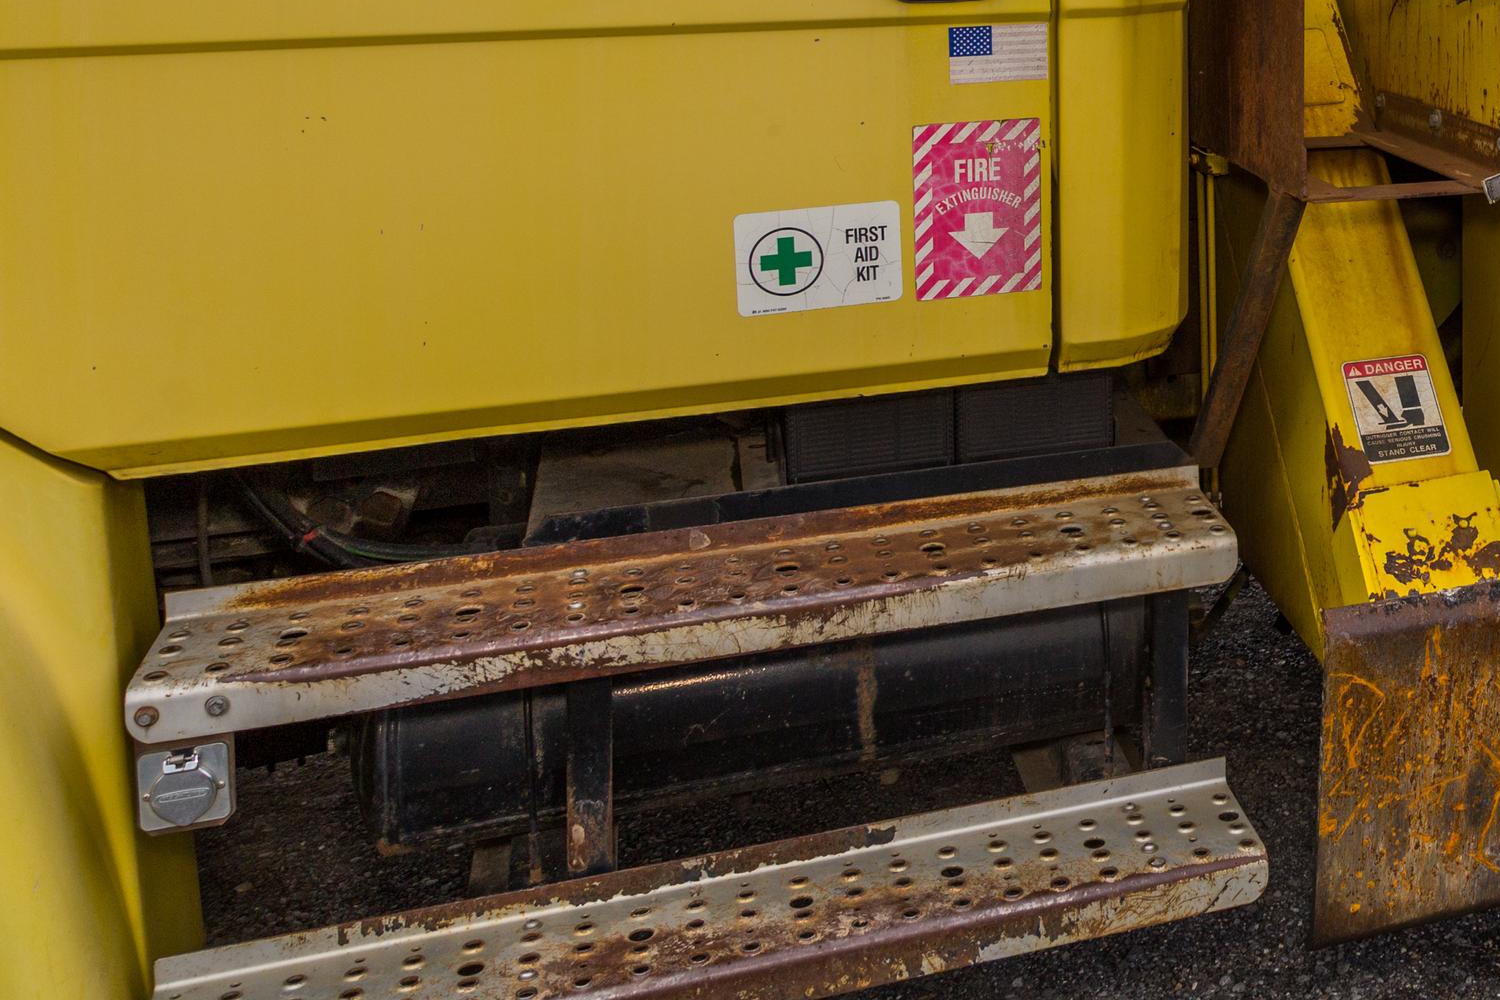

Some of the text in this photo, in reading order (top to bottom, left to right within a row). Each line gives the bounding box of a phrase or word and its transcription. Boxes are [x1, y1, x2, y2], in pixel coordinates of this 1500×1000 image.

[954, 157, 1001, 184] FIRE
[935, 187, 1022, 215] EXTINGUISHER
[845, 225, 887, 244] FIRST
[854, 246, 879, 263] AID
[857, 265, 879, 282] KIT
[1364, 359, 1423, 375] DANGER
[1365, 432, 1398, 441] OUTRIGGER
[1400, 429, 1425, 437] CONTACT
[1388, 436, 1412, 444] SERIOUS
[1414, 432, 1441, 441] CRUSHING
[1378, 444, 1437, 458] STAND CLEAR
